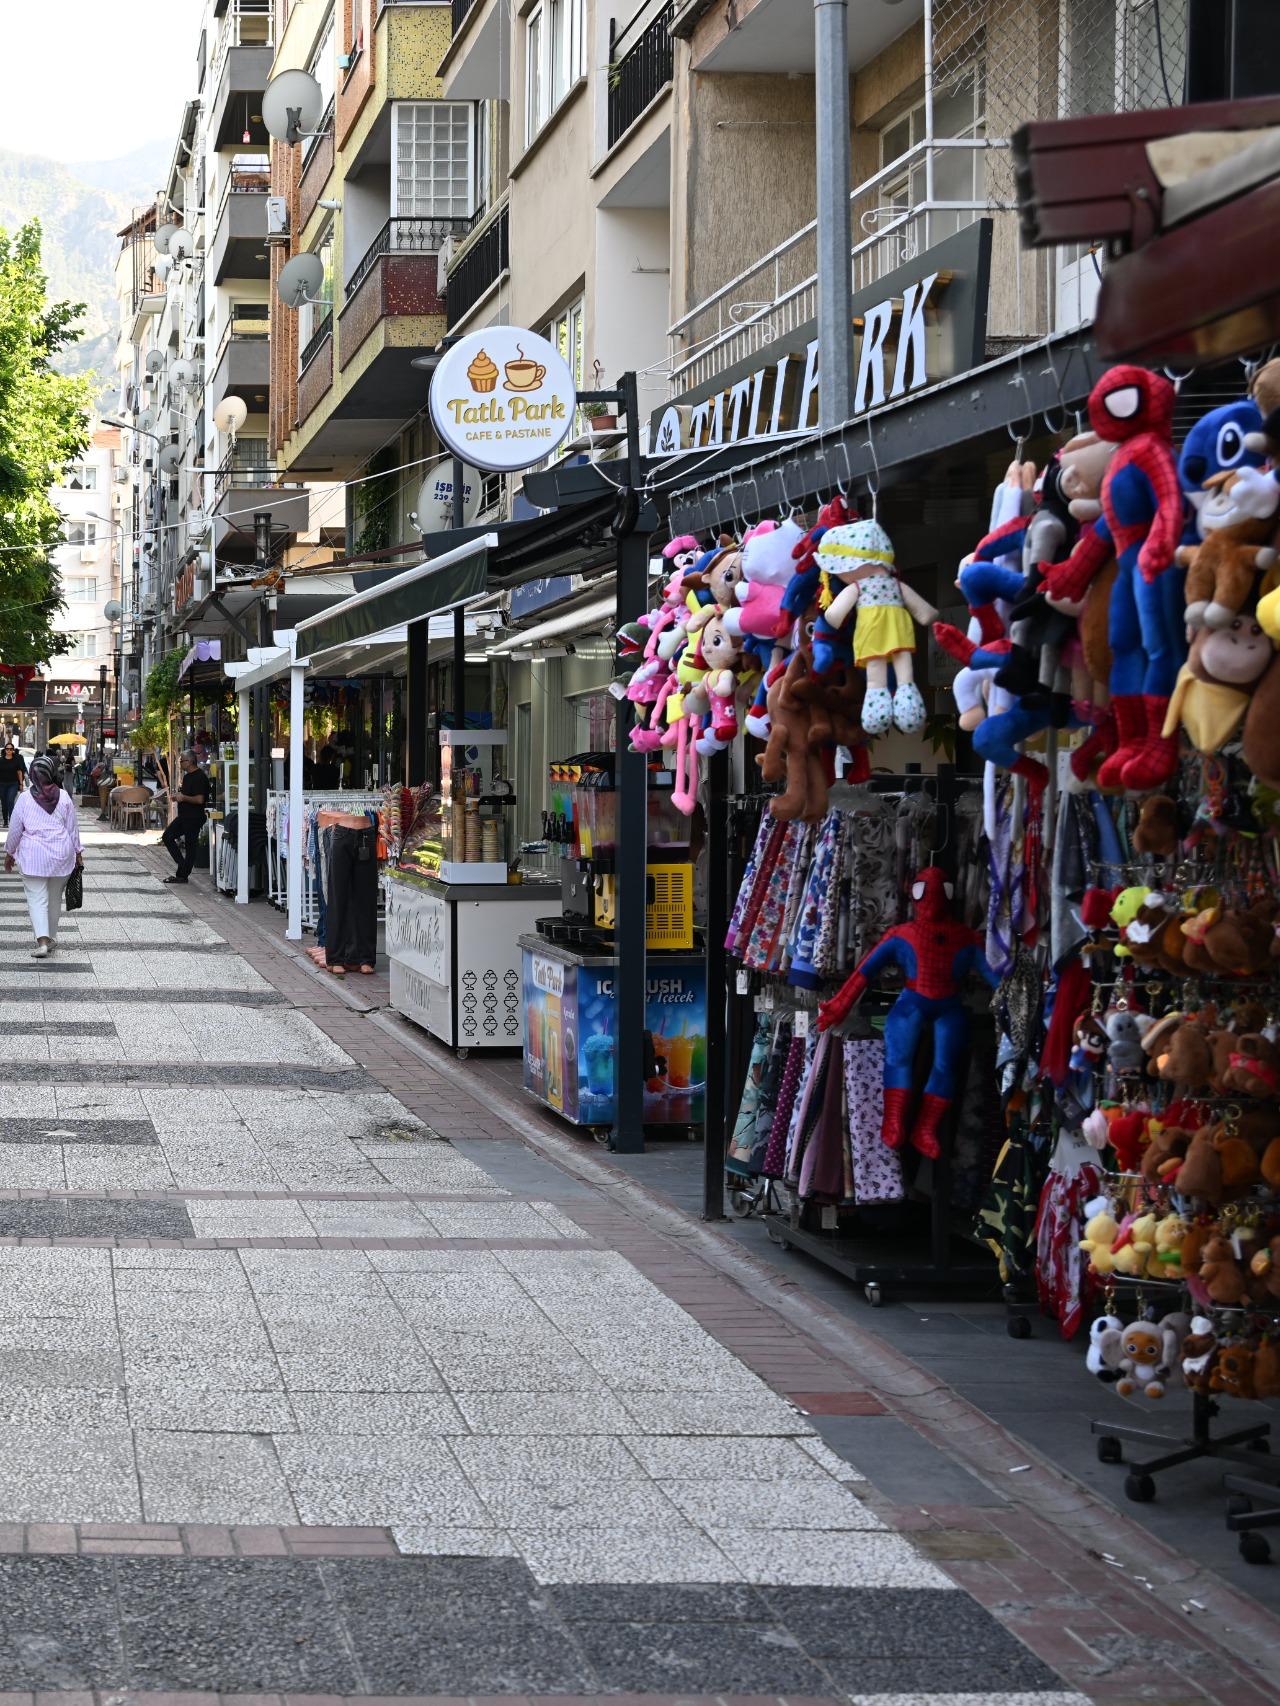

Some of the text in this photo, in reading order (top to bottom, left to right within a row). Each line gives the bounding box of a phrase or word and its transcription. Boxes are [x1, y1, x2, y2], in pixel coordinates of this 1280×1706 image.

[689, 271, 939, 448] TATLI PRK
[447, 394, 566, 425] Tatlı Park
[465, 427, 552, 441] CAFE & PASTANE
[54, 685, 97, 695] HAYAT
[596, 978, 683, 995] IC USH
